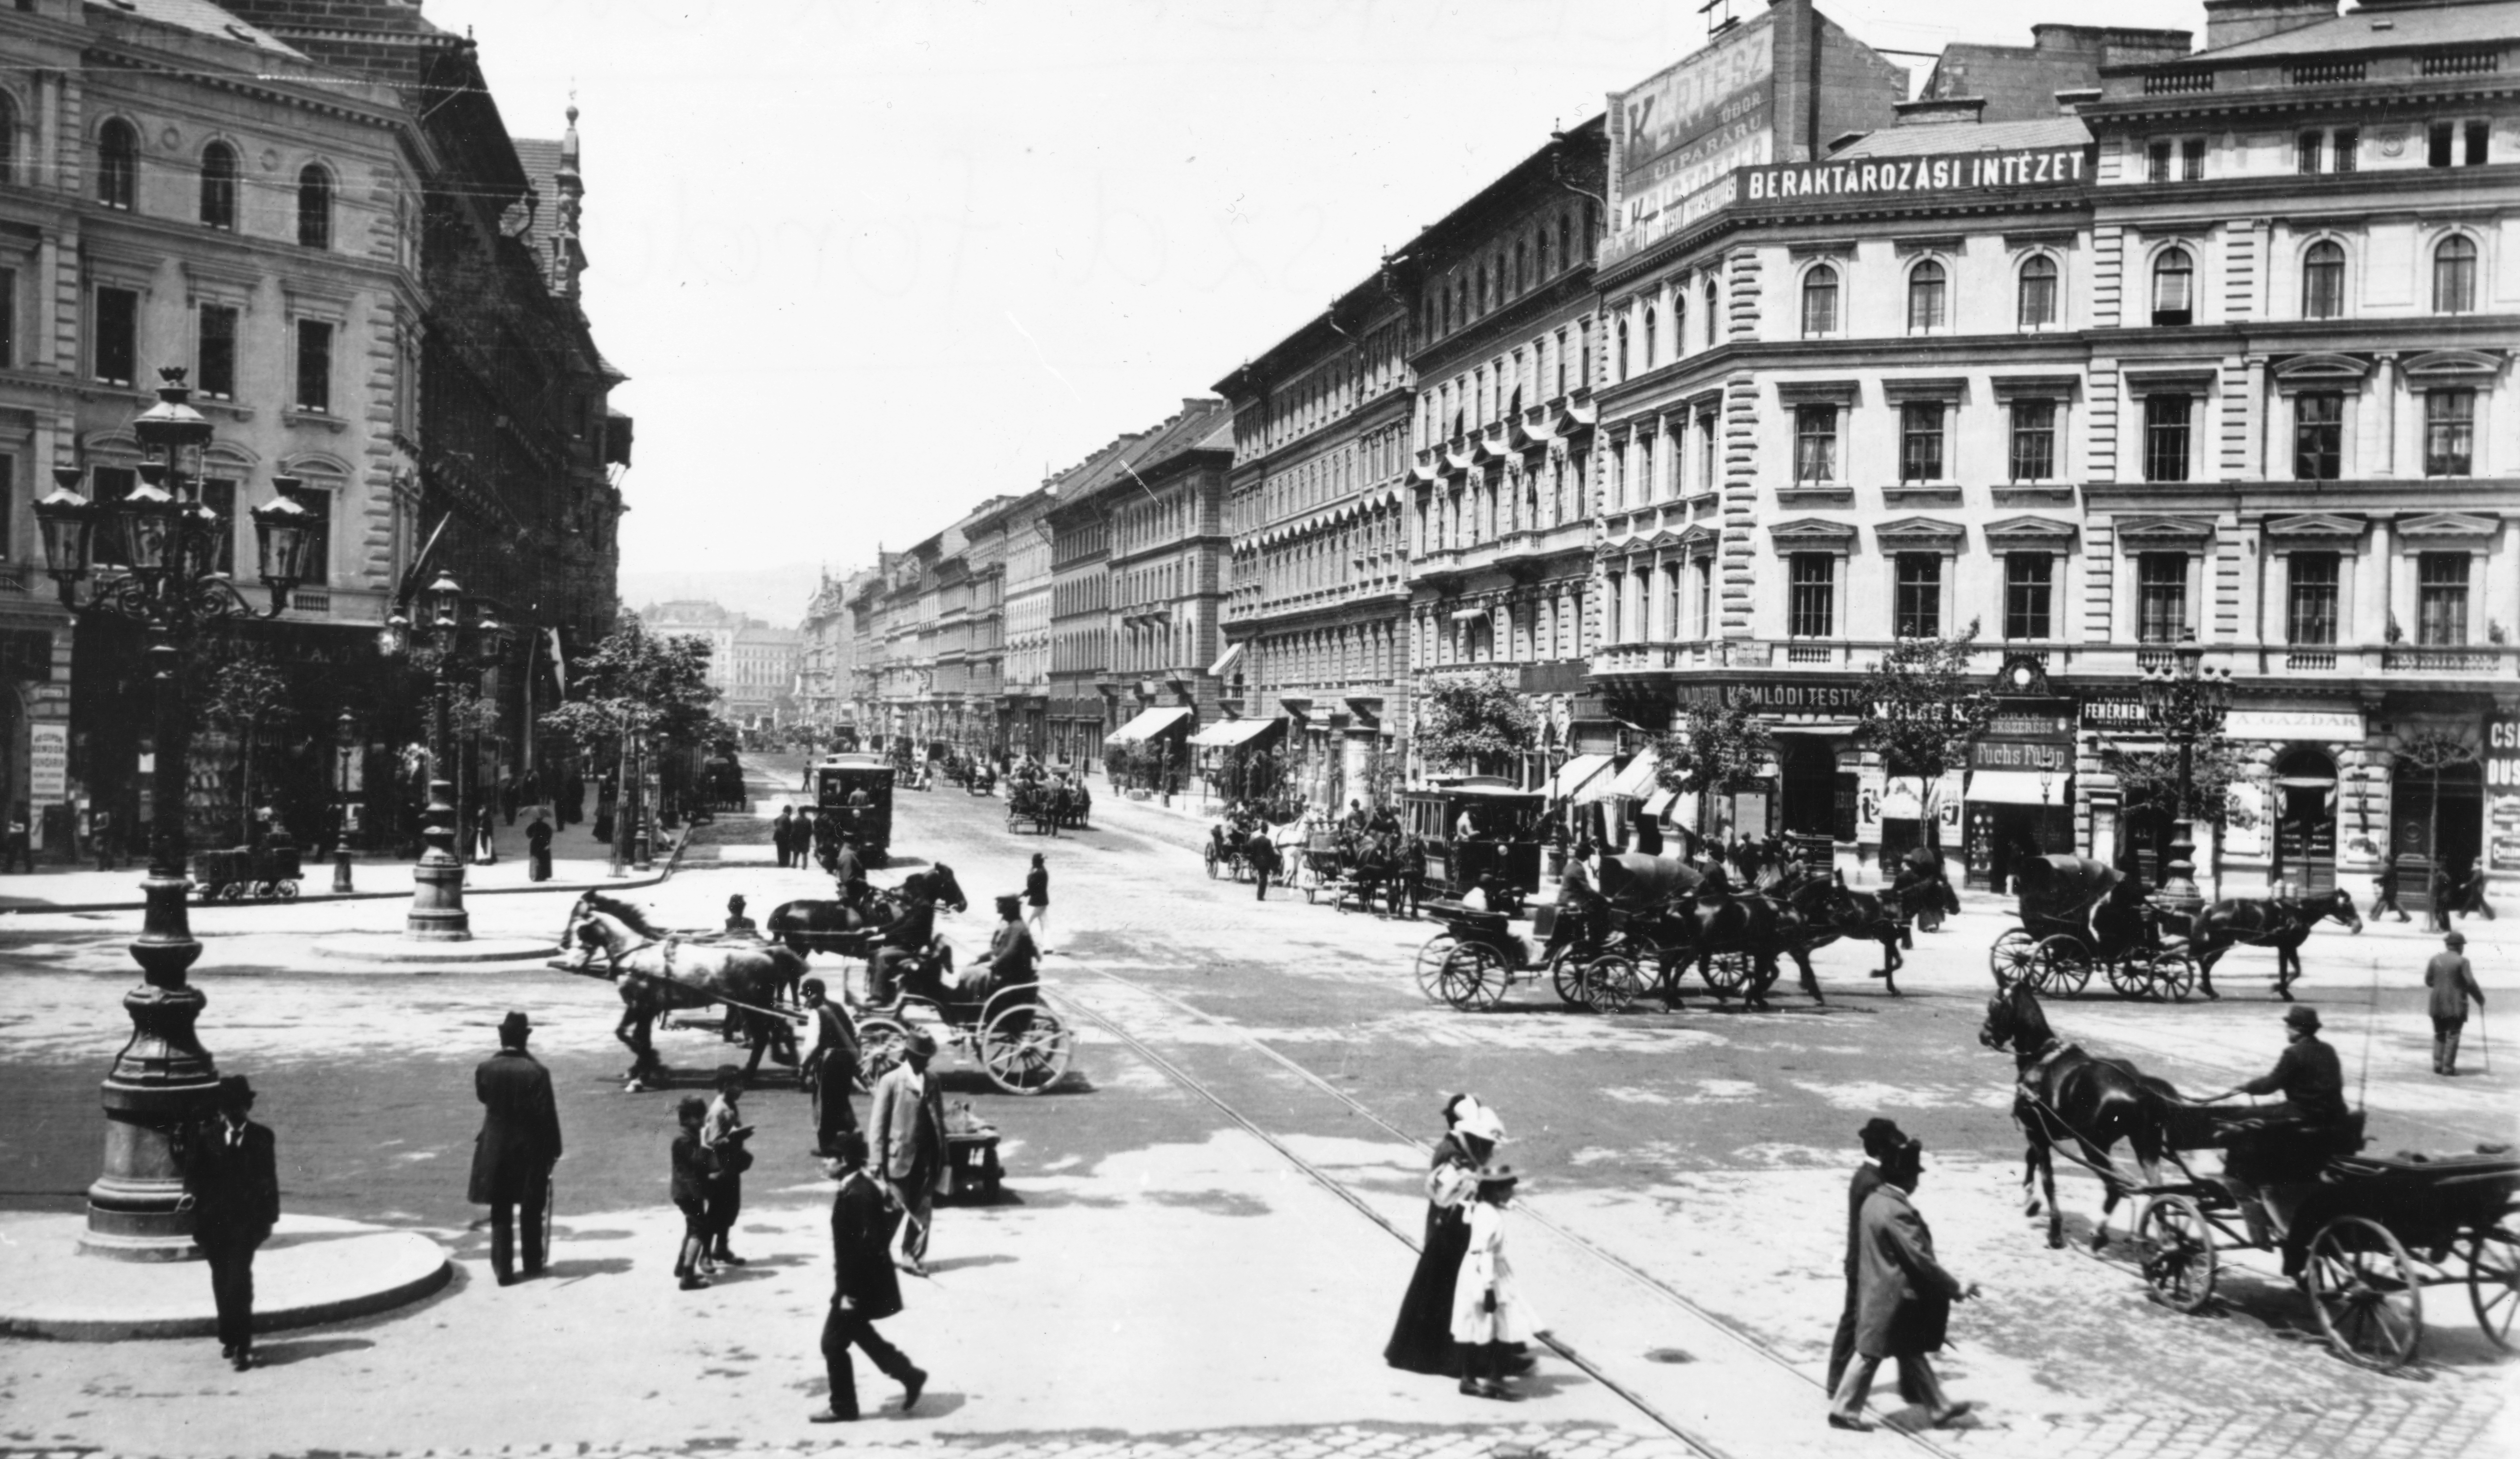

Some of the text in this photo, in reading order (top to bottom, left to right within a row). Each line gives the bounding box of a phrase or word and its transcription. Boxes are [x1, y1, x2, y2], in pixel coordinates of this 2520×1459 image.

[1749, 151, 2084, 199] BERAKTÁROZÁSI INTÉZET
[1977, 743, 2021, 764] Fuchs
